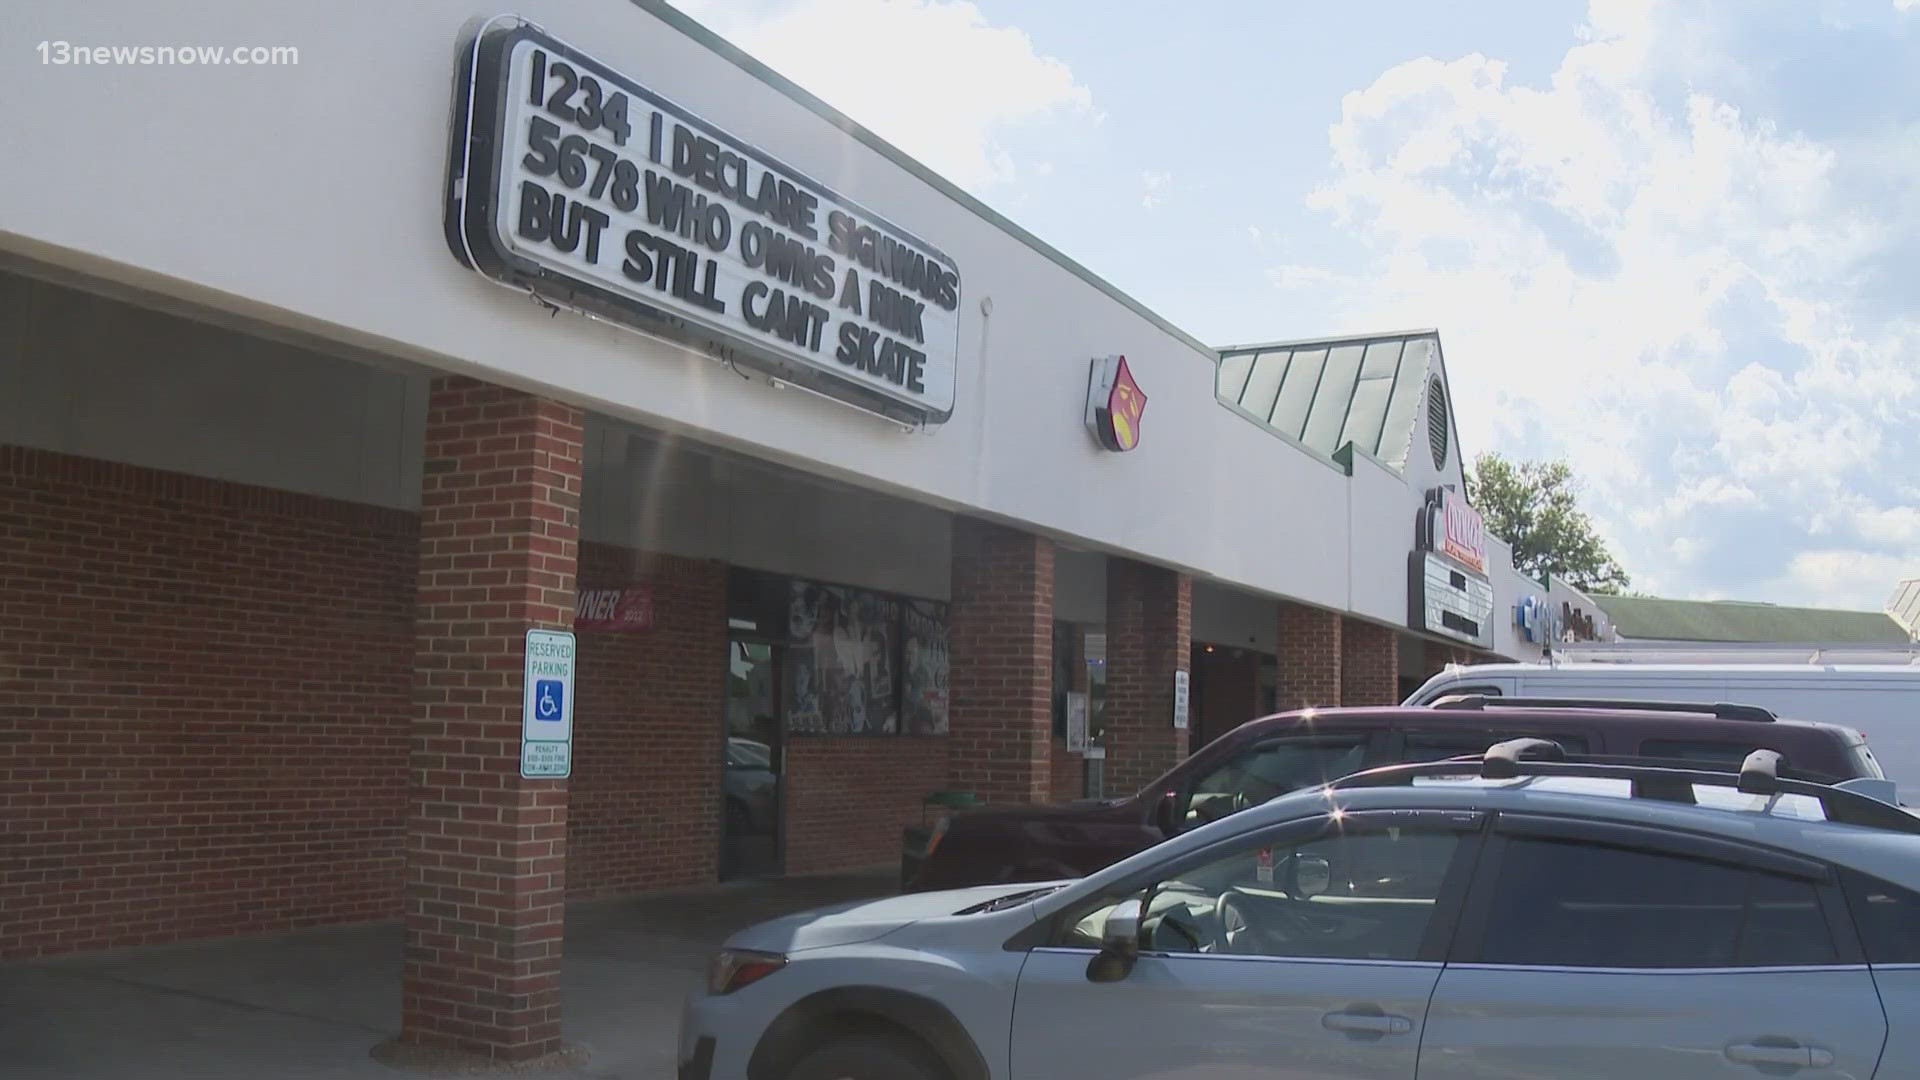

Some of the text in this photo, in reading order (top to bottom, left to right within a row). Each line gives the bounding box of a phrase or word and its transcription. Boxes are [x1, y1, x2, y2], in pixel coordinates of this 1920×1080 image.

[523, 115, 925, 345] 5678 WHO OWNS A RINK
[530, 49, 631, 147] 1234
[650, 112, 663, 164] I
[673, 124, 818, 241] DECLARE
[519, 180, 926, 394] BUT STILL CANT SKATE
[529, 641, 572, 658] RESERVED
[532, 661, 568, 677] PARKING
